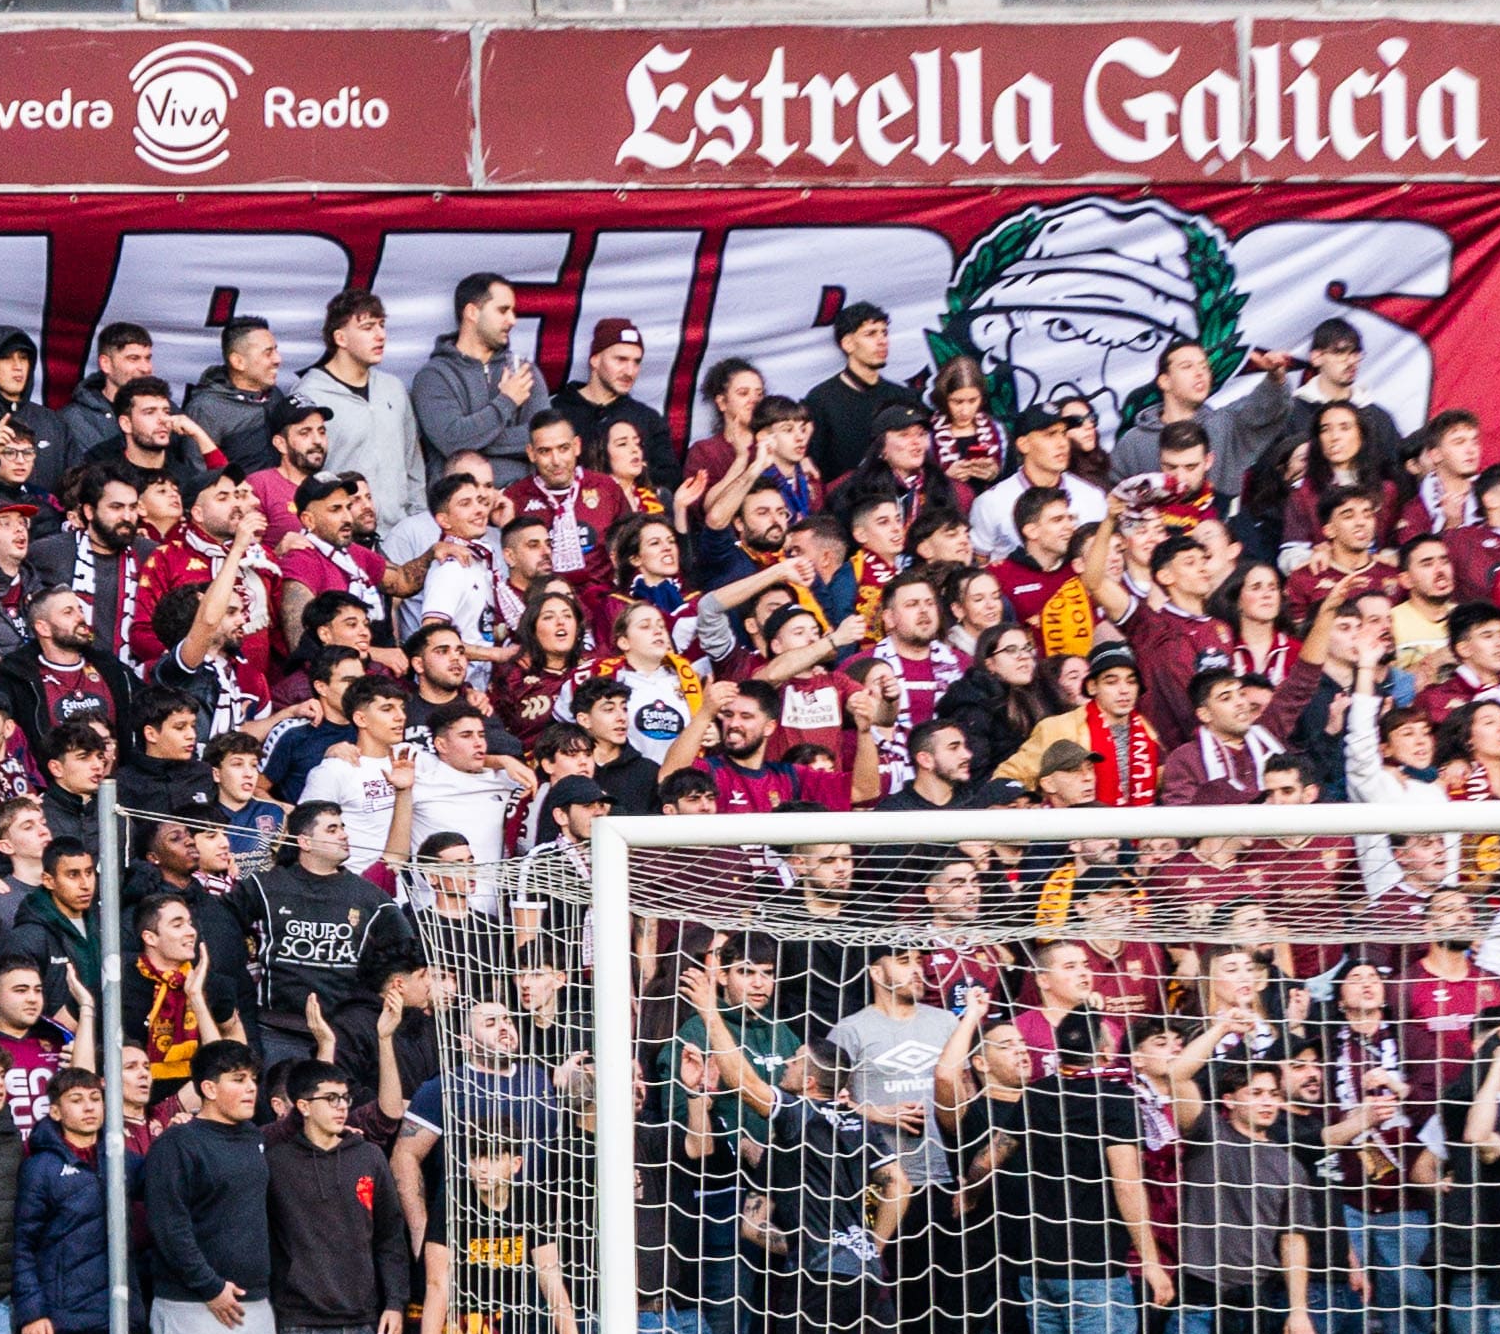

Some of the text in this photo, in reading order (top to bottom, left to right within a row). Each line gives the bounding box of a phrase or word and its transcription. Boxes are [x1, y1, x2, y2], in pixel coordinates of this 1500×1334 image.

[145, 87, 222, 129] Viva
[264, 86, 389, 129] Radio
[614, 35, 1488, 169] Estrella Galicia
[285, 919, 353, 940] GRUPO
[884, 1076, 935, 1094] umbr
